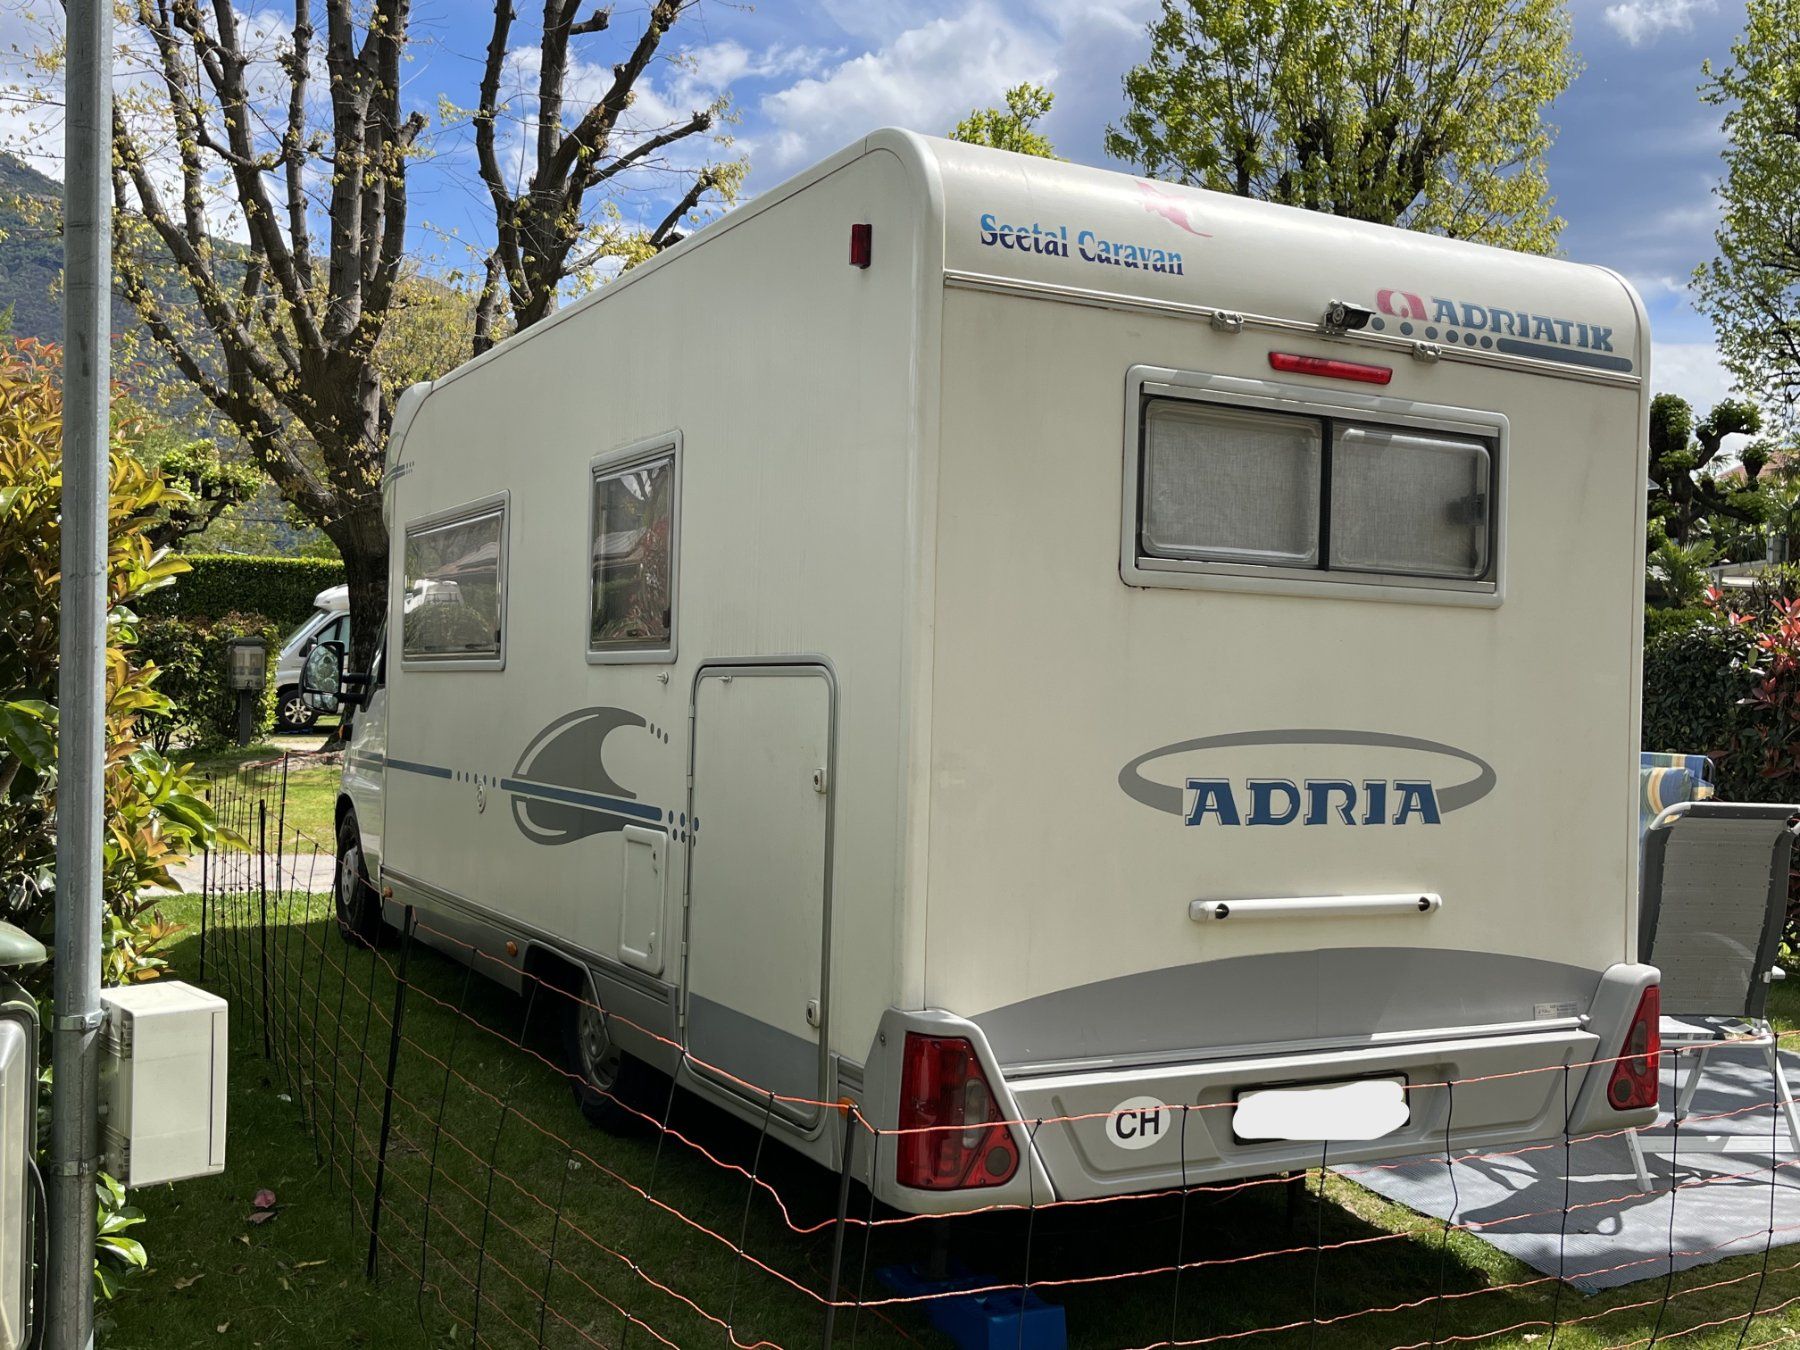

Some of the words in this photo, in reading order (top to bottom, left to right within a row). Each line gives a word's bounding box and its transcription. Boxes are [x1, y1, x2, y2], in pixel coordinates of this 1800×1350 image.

[980, 213, 1069, 258] Seetal
[1077, 230, 1185, 276] Caravan
[1430, 296, 1613, 352] ADRIATIK
[1184, 777, 1442, 827] ADRIA
[1115, 1106, 1160, 1140] CH
